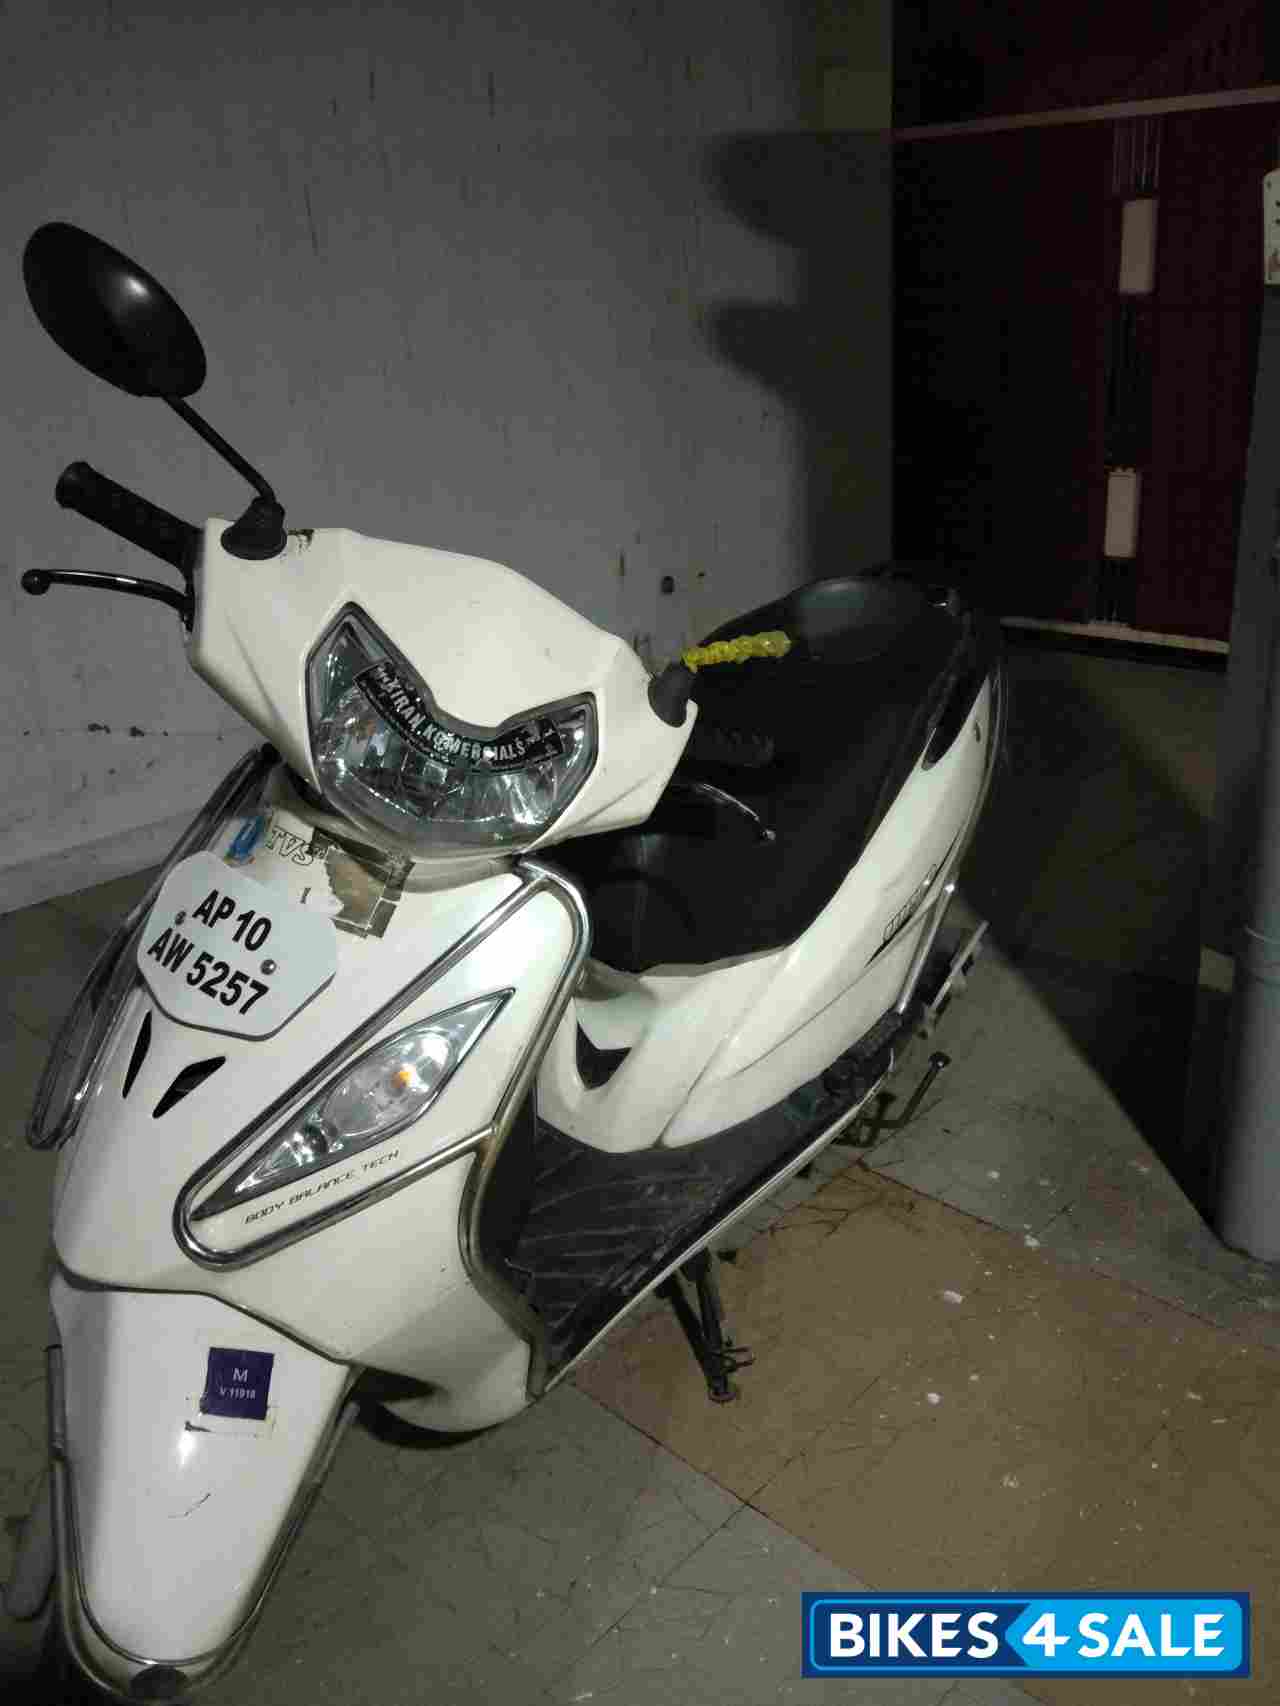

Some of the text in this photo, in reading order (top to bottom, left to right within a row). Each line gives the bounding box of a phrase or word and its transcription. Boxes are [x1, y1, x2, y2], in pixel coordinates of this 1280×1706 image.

[266, 825, 314, 866] TVS
[192, 889, 273, 952] AP 10
[147, 927, 270, 1016] AW 5257
[244, 1149, 400, 1224] BODY BALANCE TECH
[232, 1367, 248, 1383] M
